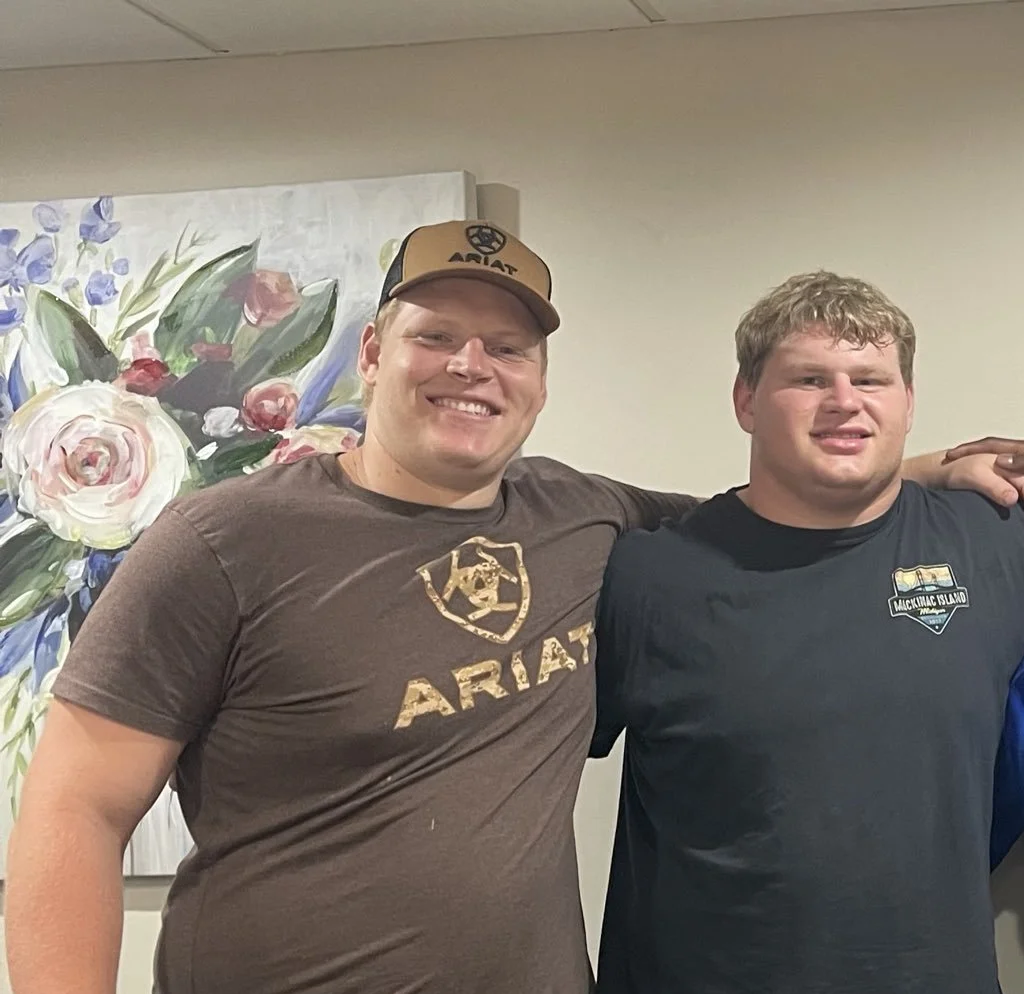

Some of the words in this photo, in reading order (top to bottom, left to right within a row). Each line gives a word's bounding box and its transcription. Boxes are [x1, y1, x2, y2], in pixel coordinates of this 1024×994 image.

[448, 251, 518, 276] ARIAT
[893, 594, 937, 612] MACKINAC
[936, 590, 967, 606] ISLAND
[393, 621, 595, 730] ARIAT
